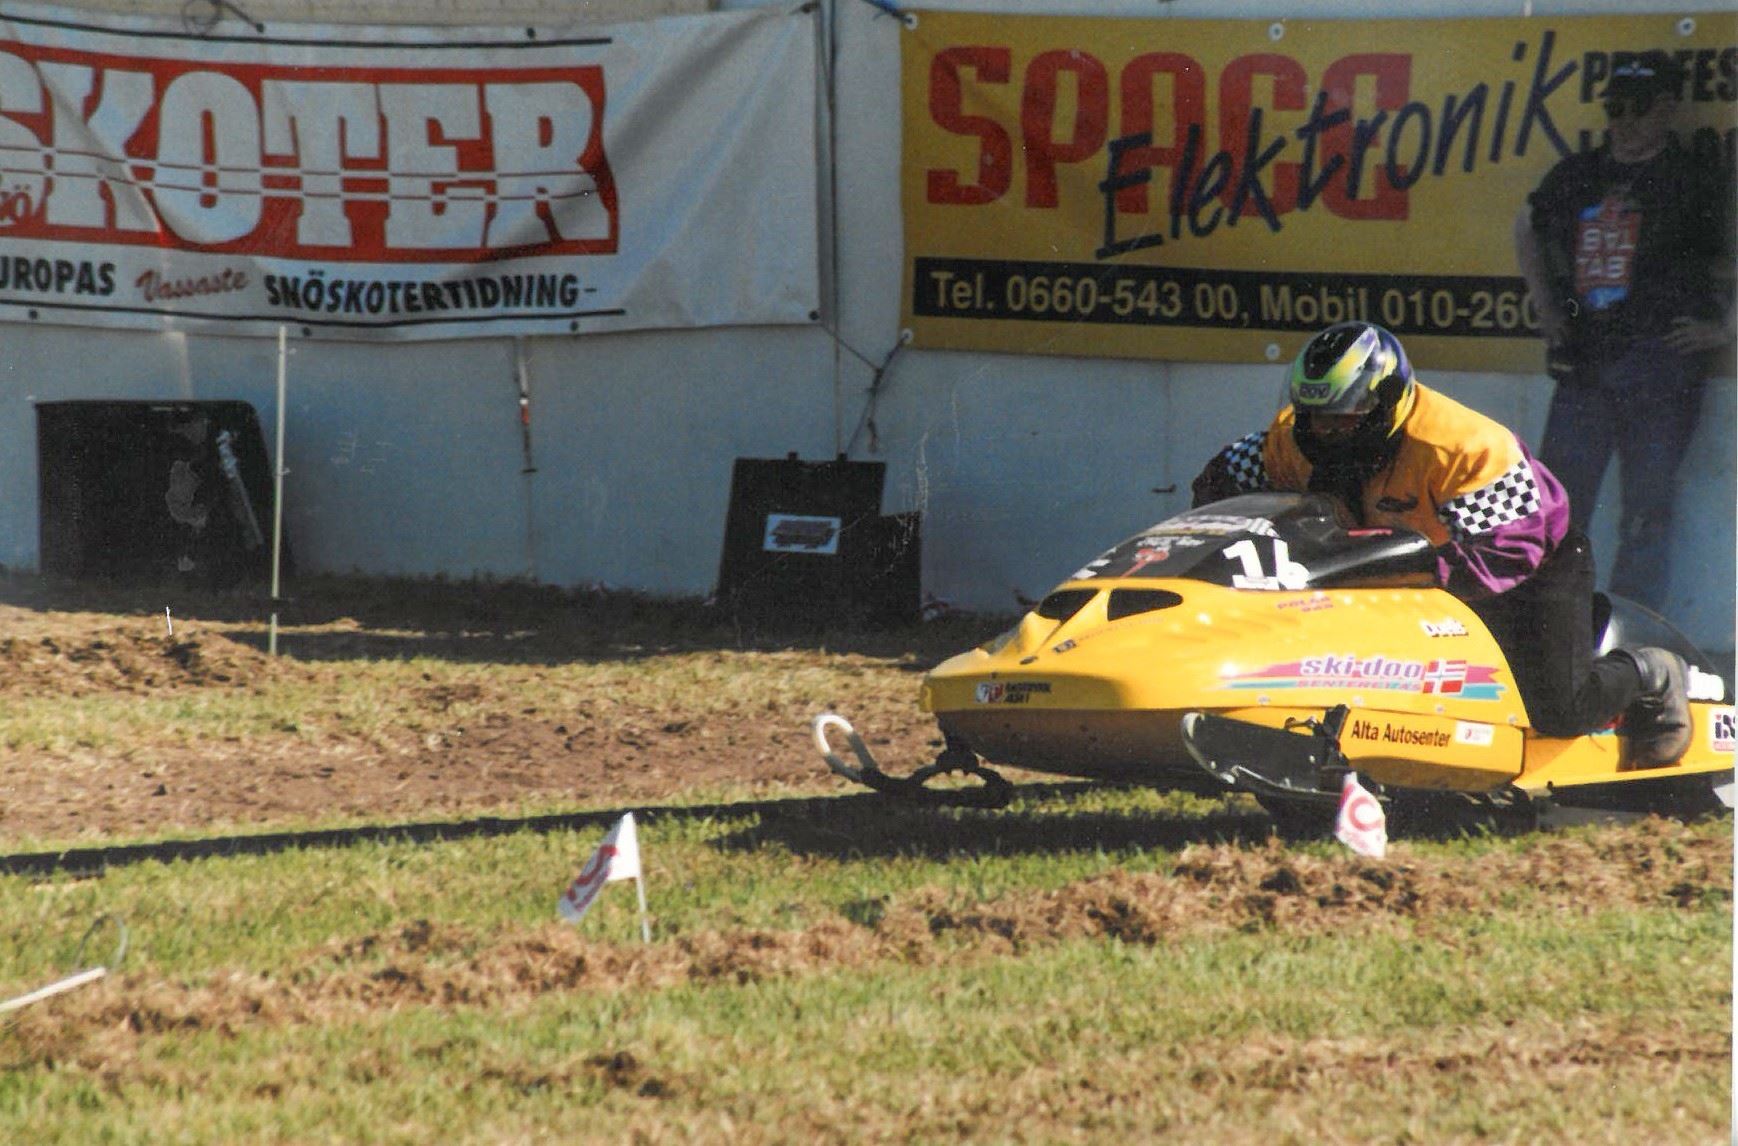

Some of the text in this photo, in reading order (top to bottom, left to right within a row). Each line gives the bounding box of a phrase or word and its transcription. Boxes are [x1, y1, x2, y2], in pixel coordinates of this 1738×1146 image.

[1096, 30, 1578, 260] Elektronik
[930, 271, 993, 310] Tel.
[1006, 274, 1183, 317] 0660-543
[1194, 283, 1248, 327] 00,
[1260, 284, 1368, 323] Mobil
[1352, 720, 1379, 740] Alta
[1383, 723, 1451, 747] Autosenter
